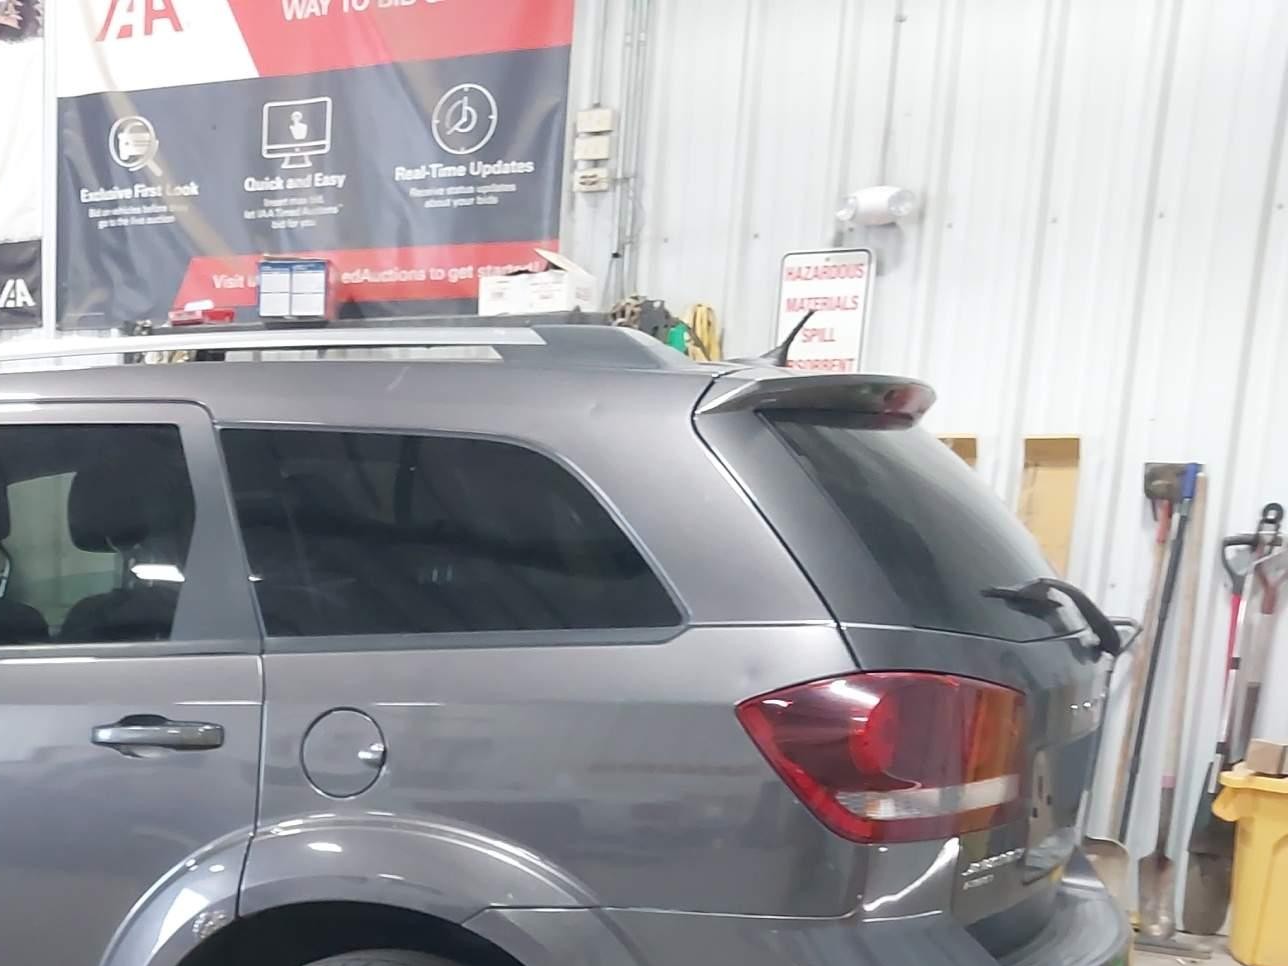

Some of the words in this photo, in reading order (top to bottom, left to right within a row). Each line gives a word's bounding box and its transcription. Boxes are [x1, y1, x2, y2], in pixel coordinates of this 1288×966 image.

[395, 163, 467, 180] Real-Time
[469, 160, 534, 178] Updates
[244, 177, 285, 191] Quick
[286, 175, 312, 189] and
[314, 173, 347, 188] Easy
[80, 186, 132, 203] Exclusive
[133, 183, 163, 199] First
[165, 181, 199, 196] Look
[429, 268, 445, 281] to
[448, 265, 473, 283] get
[785, 263, 864, 281] HAZARDOUS
[785, 295, 859, 312] MATERIALS
[802, 327, 836, 343] SPILL
